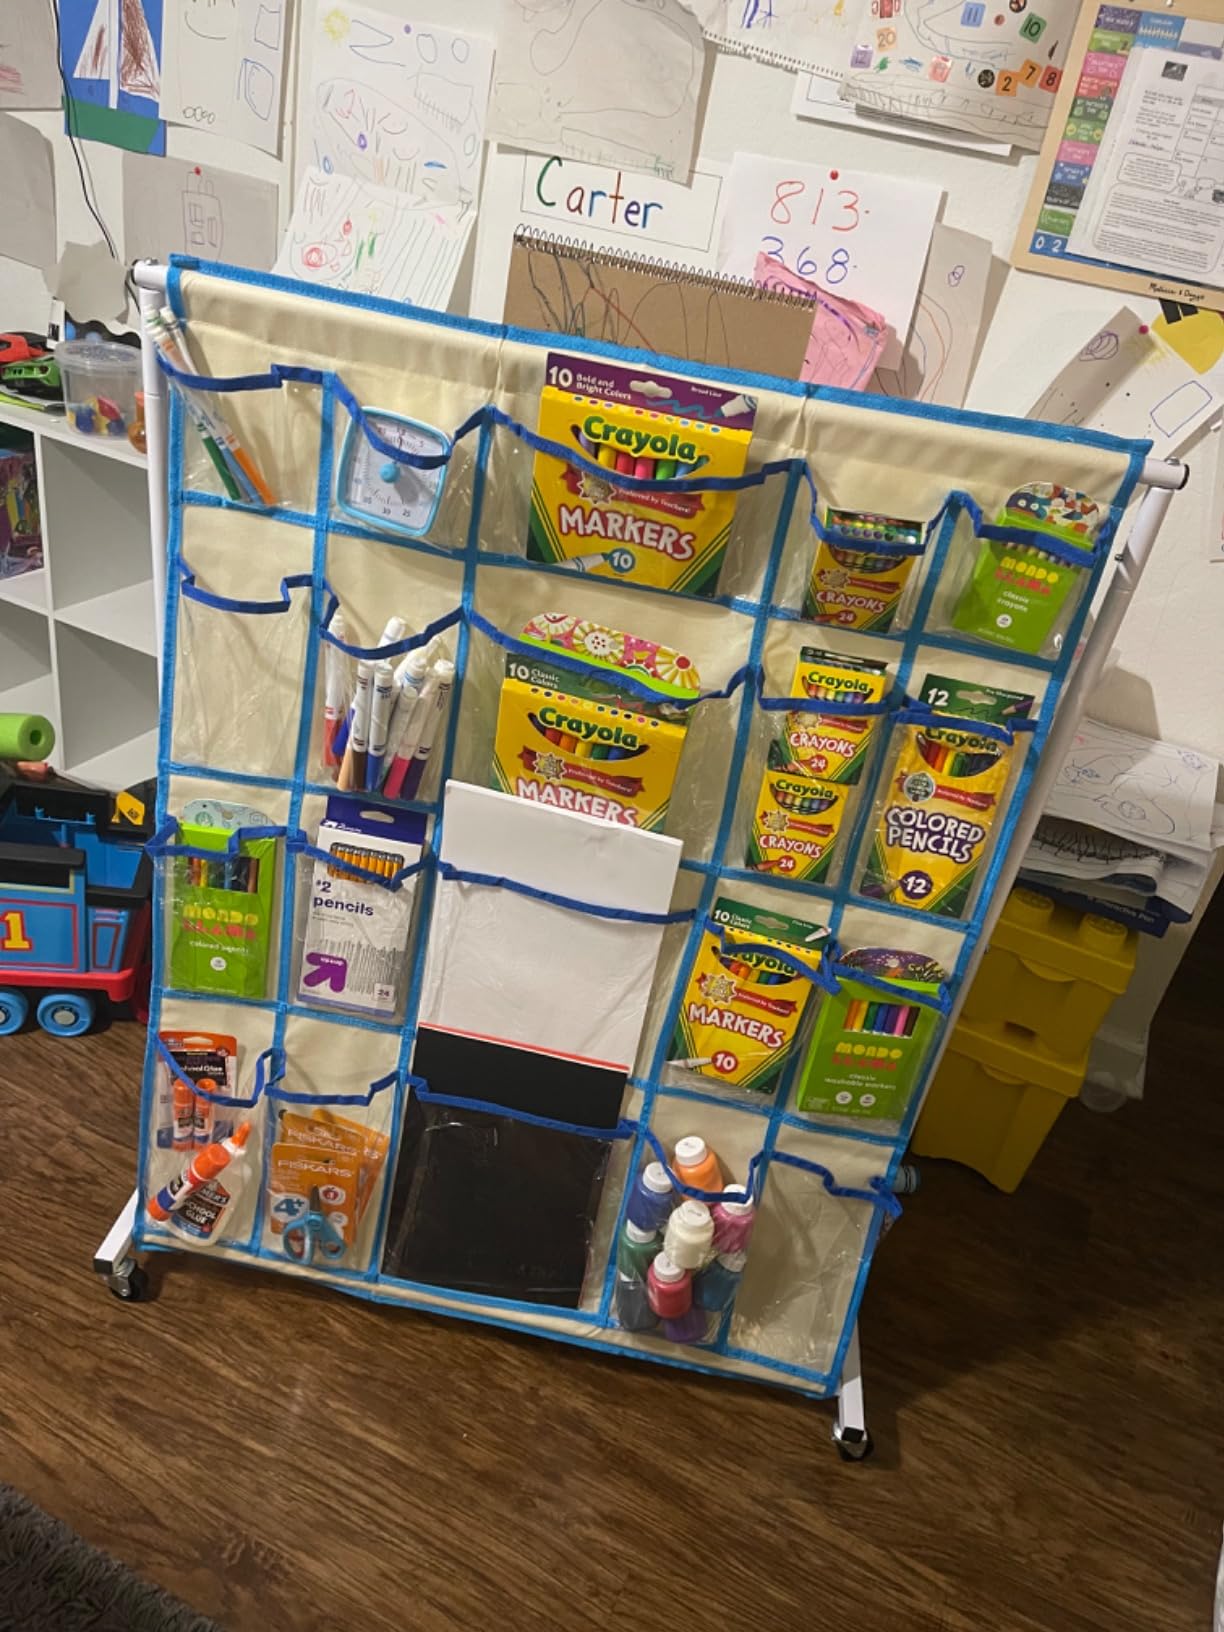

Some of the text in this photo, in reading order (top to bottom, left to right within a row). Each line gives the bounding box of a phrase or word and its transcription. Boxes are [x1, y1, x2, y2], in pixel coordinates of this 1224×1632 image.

[1024, 18, 1041, 38] 10
[1025, 65, 1036, 80] 7
[1046, 72, 1057, 88] 8
[1002, 76, 1012, 92] 2
[536, 155, 664, 229] Carter
[549, 365, 573, 388] 10
[576, 373, 615, 388] Bold and
[576, 382, 632, 401] Bright Colors
[583, 415, 697, 462] Crayola
[558, 504, 696, 561] MARKERS
[611, 551, 633, 569] 10
[816, 591, 887, 614] CRAYONS
[839, 612, 855, 621] 24
[509, 662, 529, 680] 10
[530, 668, 561, 683] Classic
[530, 676, 559, 689] Colors
[808, 671, 870, 692] Crayola
[927, 687, 950, 707] 12
[538, 706, 639, 748] Crayola
[789, 732, 857, 758] CRAYONS
[810, 758, 826, 770] 24
[775, 779, 834, 798] Crayola
[515, 777, 638, 827] MARKERS
[886, 807, 984, 843] COLORED
[759, 834, 822, 859] CRAYONS
[888, 825, 973, 863] PENCILS
[779, 859, 794, 869] 24
[905, 875, 928, 894] 12
[313, 896, 375, 917] pencils
[714, 909, 730, 922] 10
[688, 1003, 784, 1049] MARKERS
[714, 1053, 735, 1070] 10
[277, 1159, 354, 1178] FISKARS
